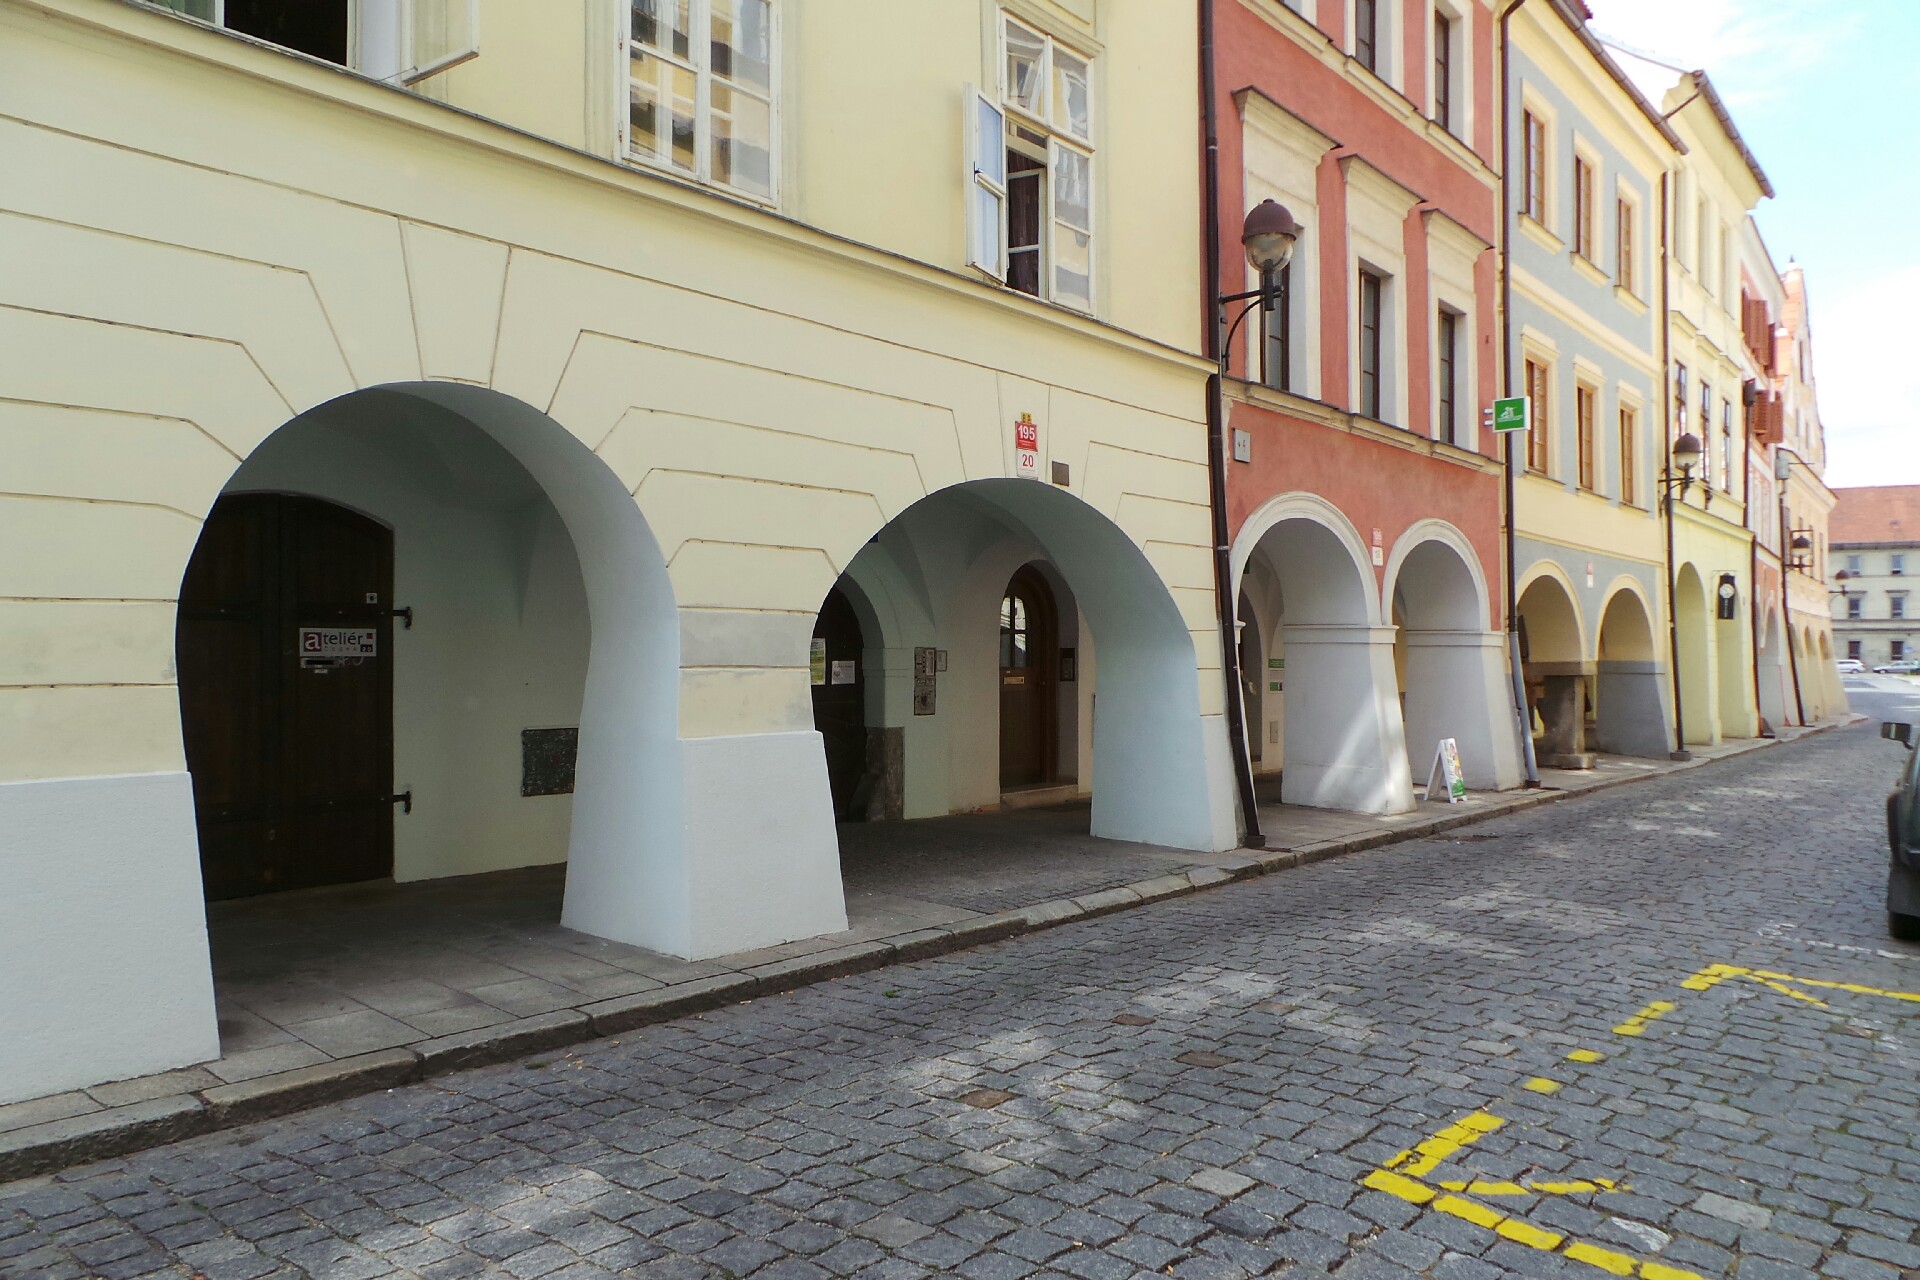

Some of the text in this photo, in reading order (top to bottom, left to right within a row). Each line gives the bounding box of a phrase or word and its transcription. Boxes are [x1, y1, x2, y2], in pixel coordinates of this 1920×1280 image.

[1018, 425, 1035, 440] 195
[1022, 454, 1034, 467] 20
[305, 632, 362, 649] ateliér
